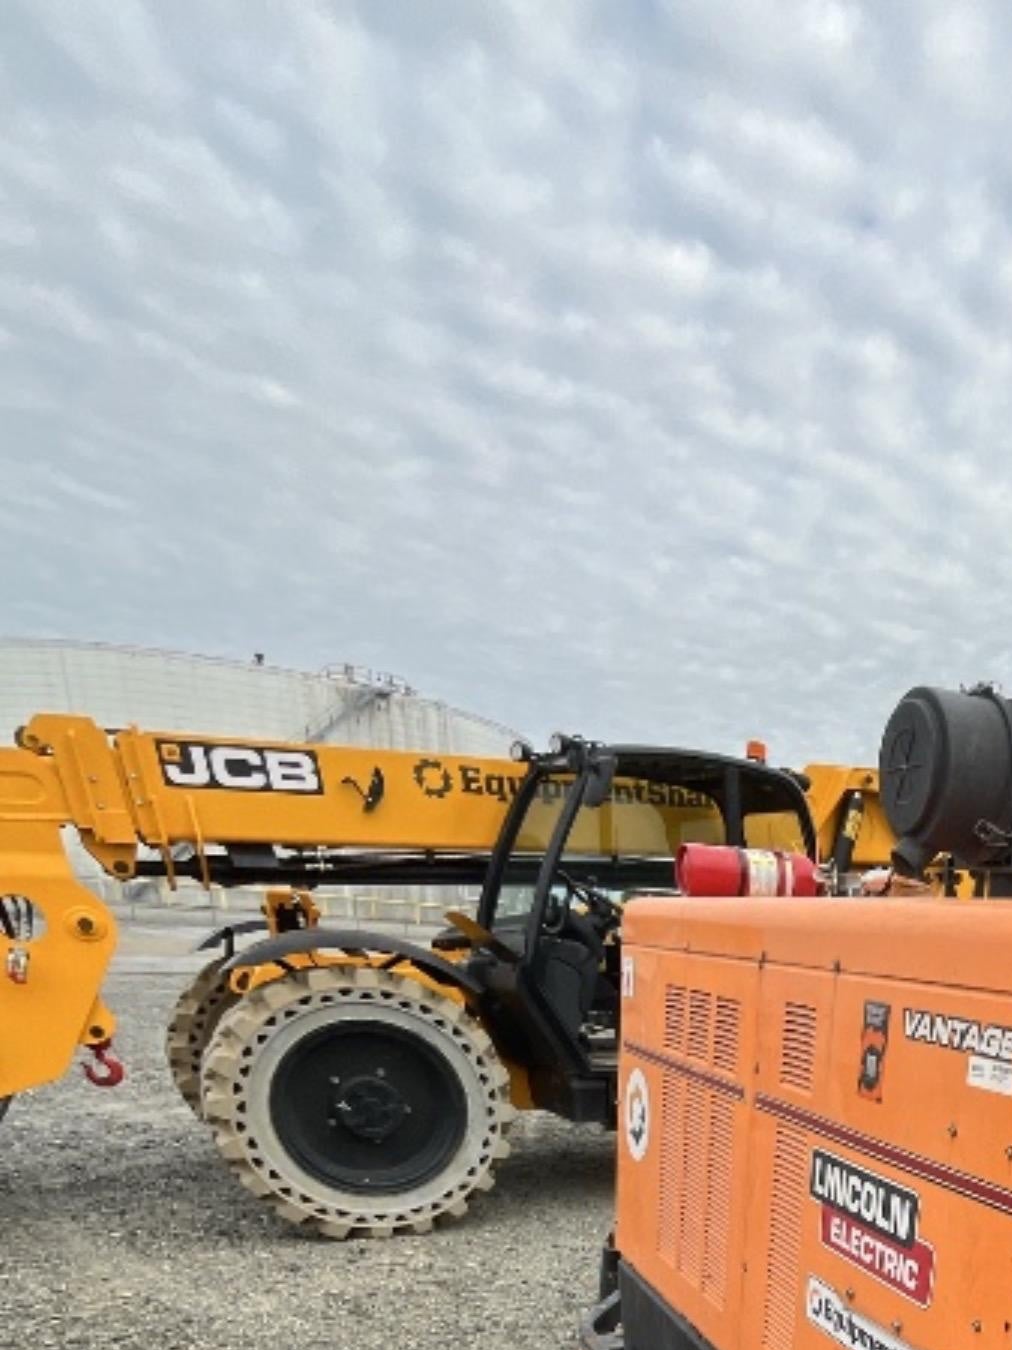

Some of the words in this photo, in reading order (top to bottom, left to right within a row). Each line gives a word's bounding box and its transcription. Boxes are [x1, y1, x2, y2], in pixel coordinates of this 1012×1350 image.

[164, 745, 320, 791] JCB
[813, 1156, 912, 1242] LINCOLN
[829, 1216, 921, 1291] ELECTRIC
